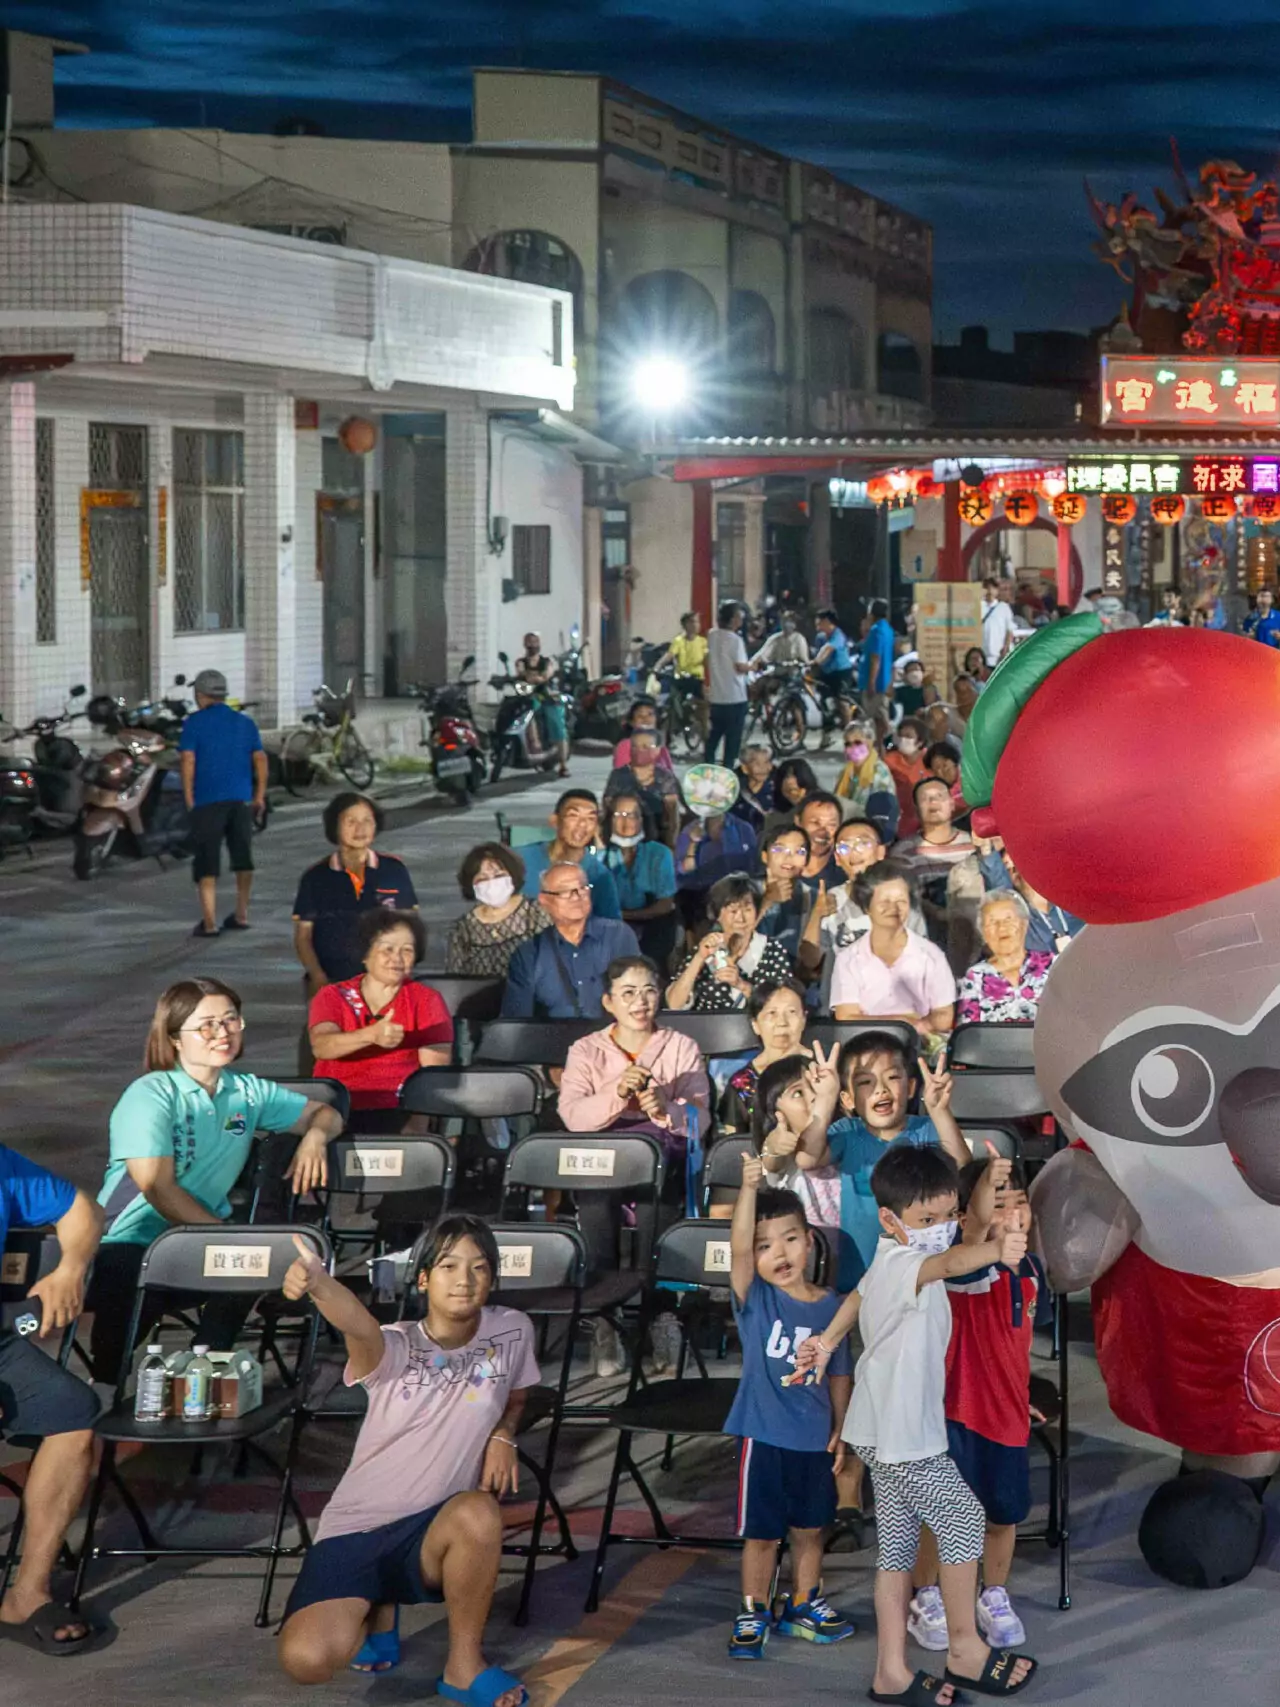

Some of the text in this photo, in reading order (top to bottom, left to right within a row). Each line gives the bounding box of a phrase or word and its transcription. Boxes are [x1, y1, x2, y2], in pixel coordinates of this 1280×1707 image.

[1193, 464, 1246, 492] 祈求
[213, 1252, 263, 1270] 貴賓席
[499, 1252, 529, 1269] 賓席
